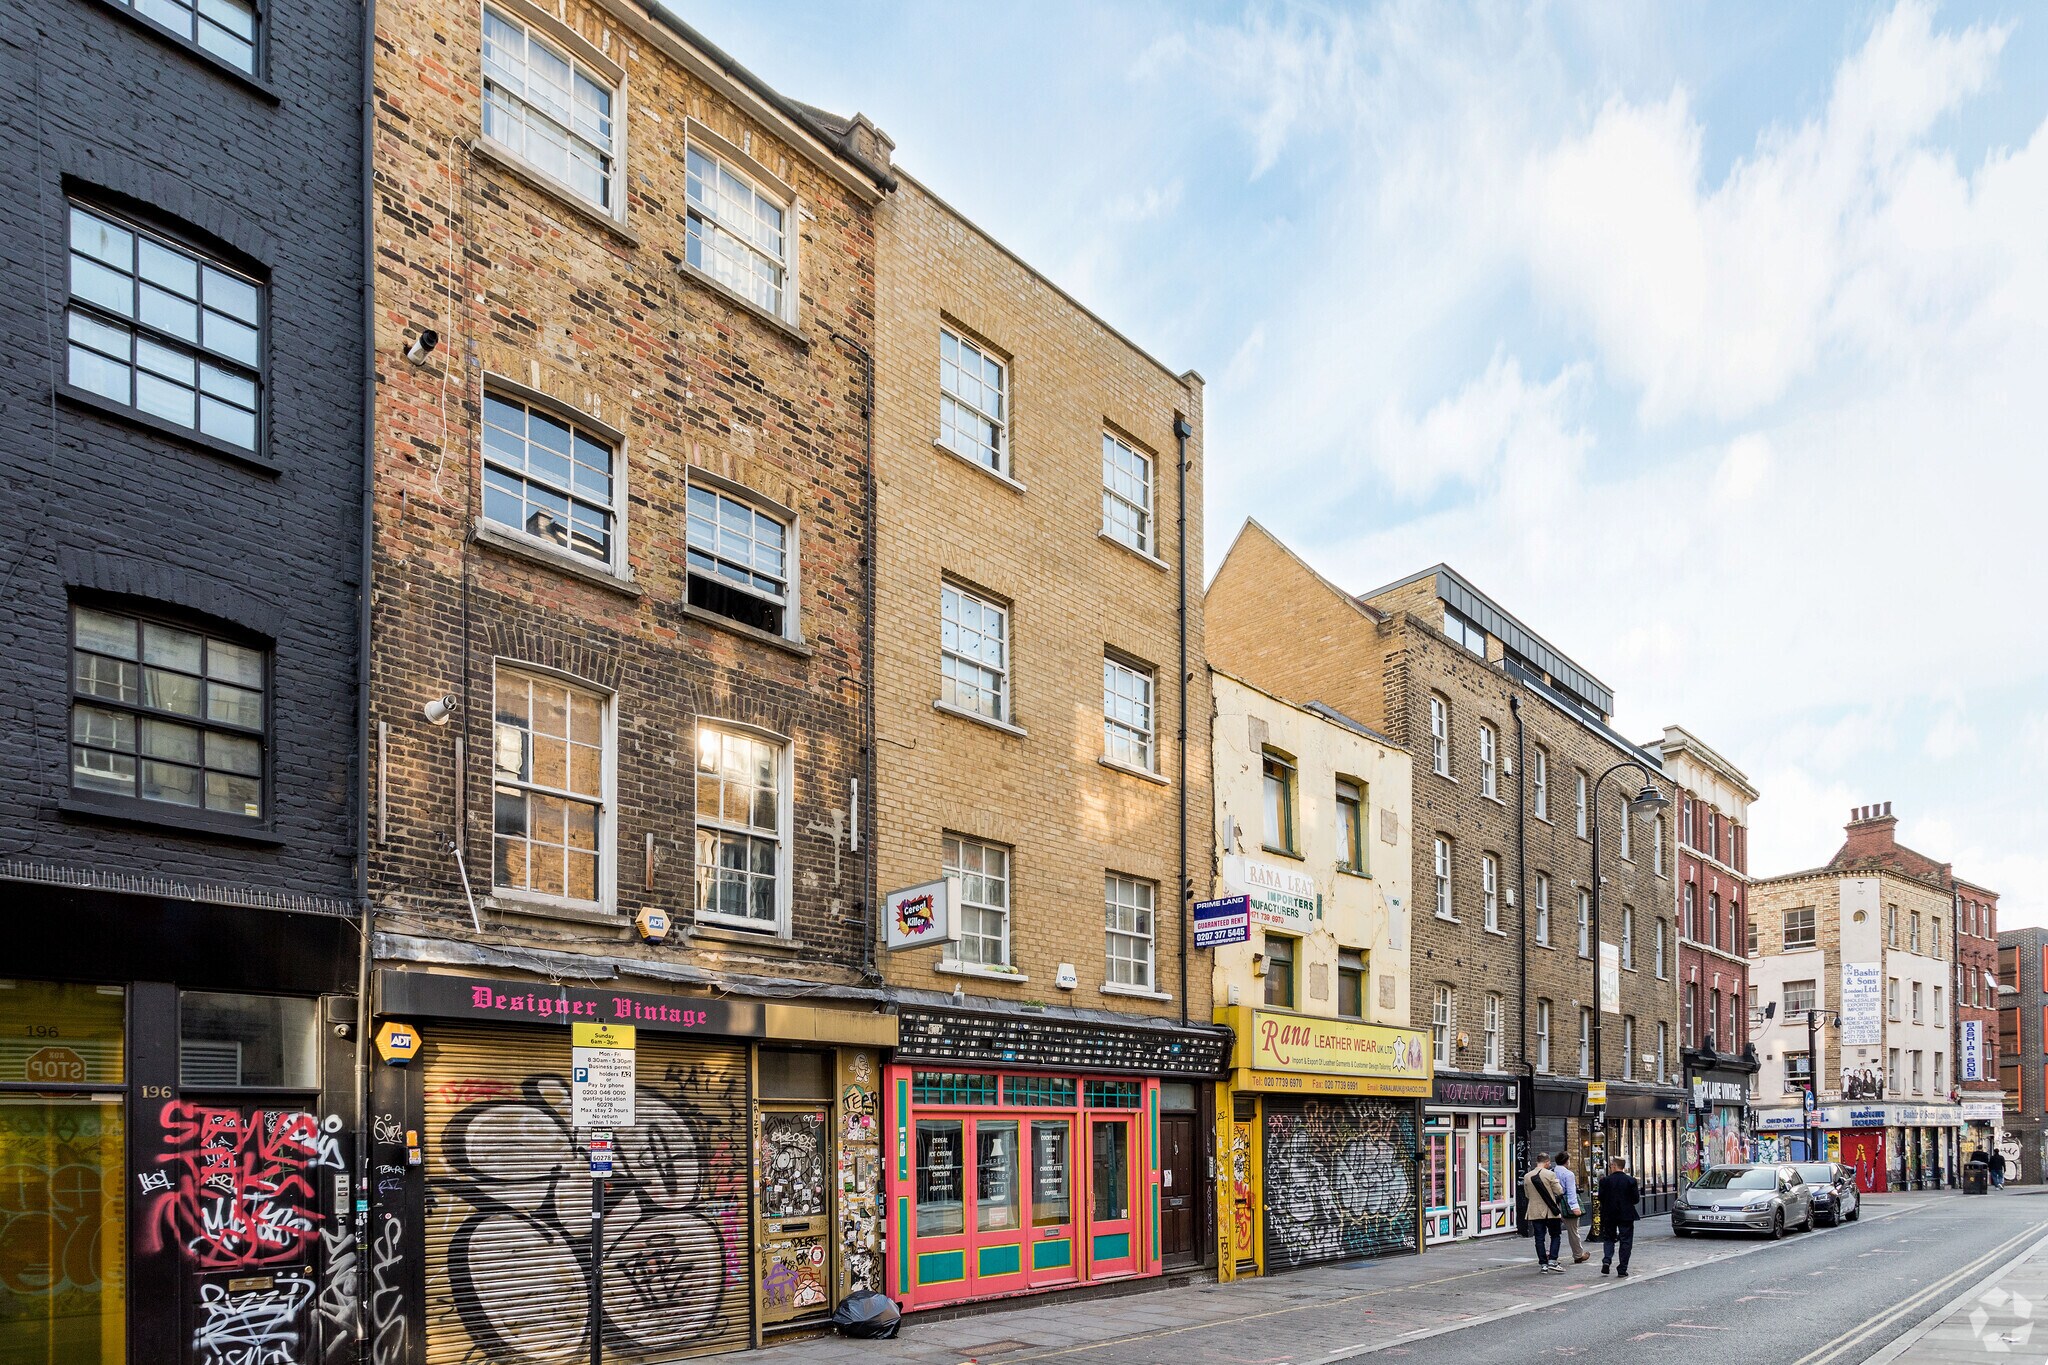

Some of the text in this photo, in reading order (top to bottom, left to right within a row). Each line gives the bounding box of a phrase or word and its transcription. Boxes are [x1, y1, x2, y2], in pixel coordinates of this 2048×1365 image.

[1250, 866, 1282, 888] RANA
[1197, 897, 1243, 909] PRIME LAND
[1268, 891, 1313, 910] IMPORTERS
[904, 900, 927, 915] Cereal
[649, 917, 664, 928] ADT
[907, 917, 925, 927] Killer
[1198, 919, 1229, 929] GUARANTEED
[1197, 932, 1213, 941] 0207
[1215, 930, 1226, 939] 377
[472, 986, 707, 1028] Designer Vintage
[25, 1025, 59, 1038] 196
[391, 1035, 411, 1046] ADT
[1261, 1020, 1311, 1064] Rana
[1315, 1034, 1352, 1050] LEATHER
[1354, 1039, 1376, 1052] WEAR
[1967, 1058, 1975, 1077] SONS
[577, 1070, 586, 1080] P
[1252, 1076, 1262, 1086] Tel:
[1264, 1077, 1274, 1086] 020
[1276, 1078, 1288, 1087] 7739
[1290, 1079, 1302, 1088] 6970
[1312, 1080, 1323, 1088] Fax:
[1324, 1080, 1333, 1089] 020
[1335, 1081, 1346, 1089] 7739
[1347, 1082, 1358, 1090] 6991
[142, 1085, 172, 1098] 196
[1440, 1083, 1462, 1100] NOT
[1462, 1083, 1504, 1100] ANOTHER
[1709, 1082, 1721, 1099] LANE
[1721, 1082, 1741, 1100] VINTAGE
